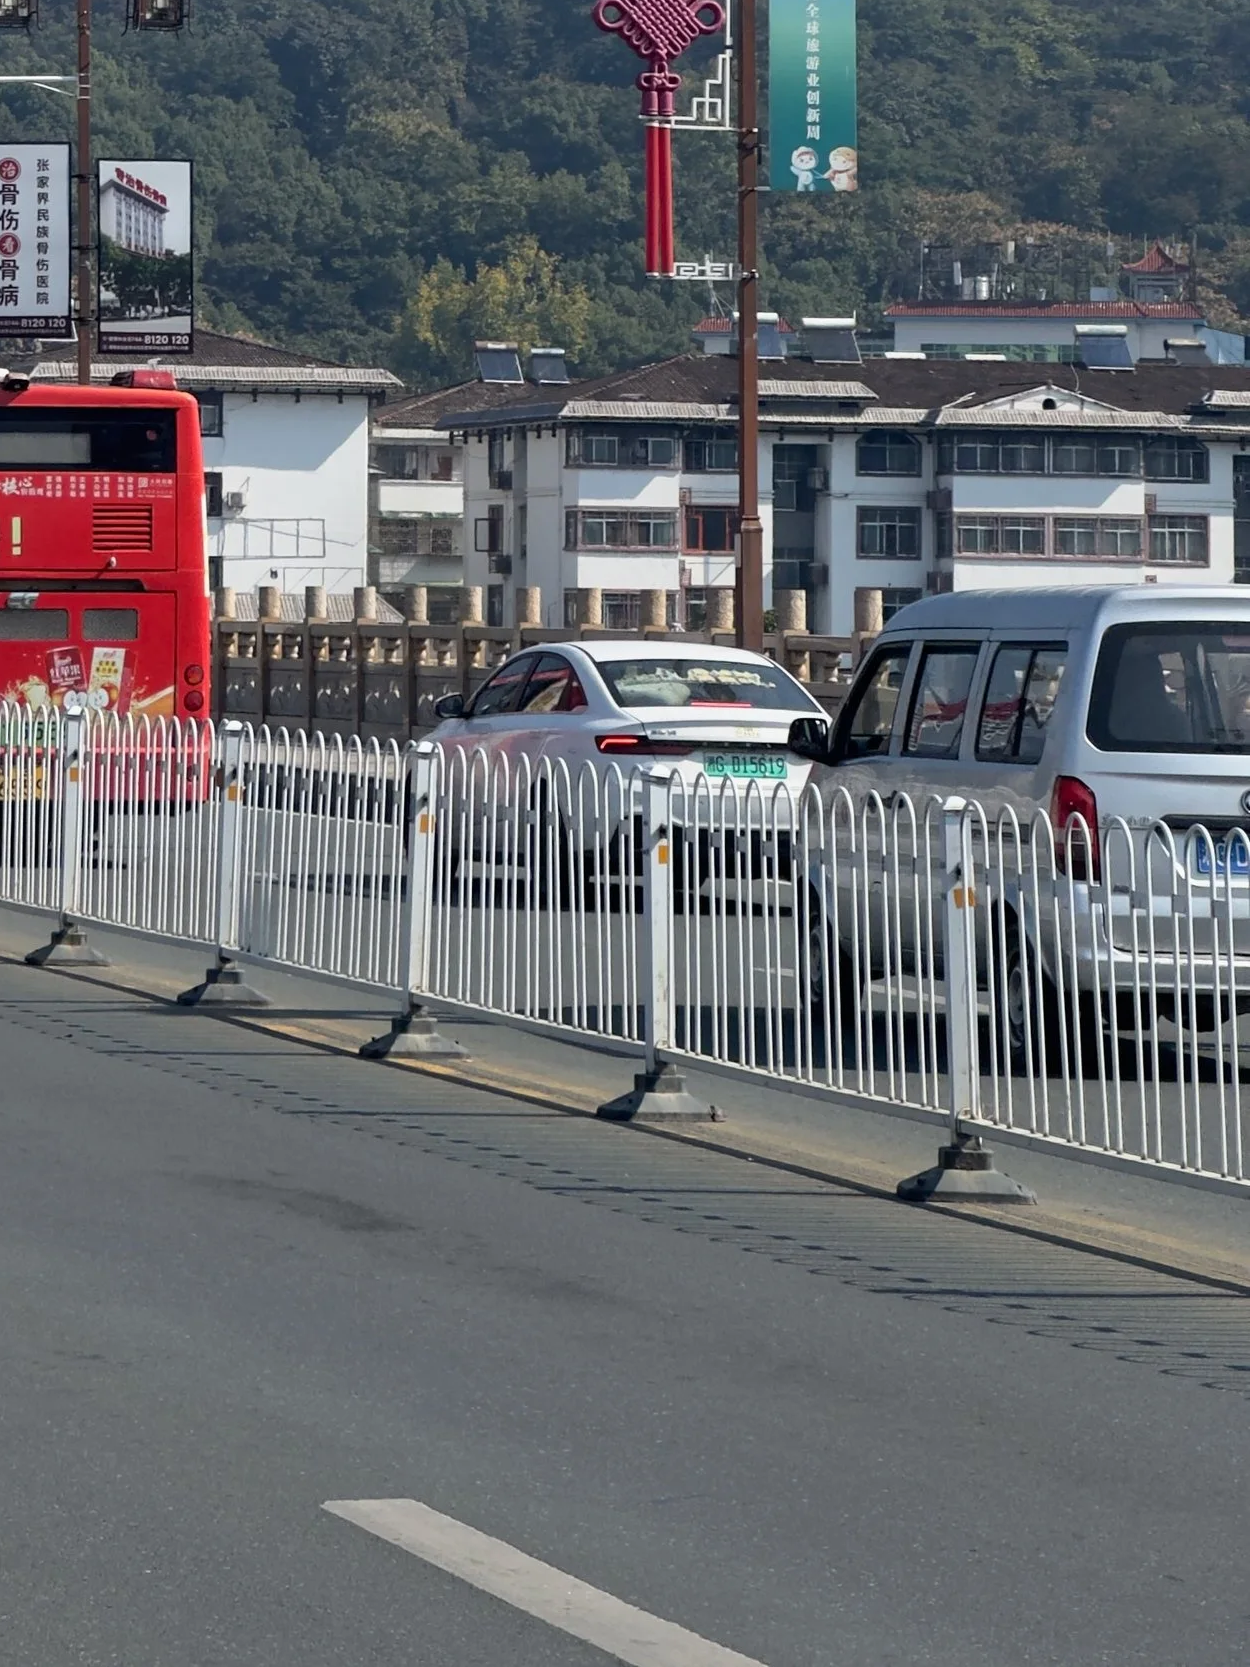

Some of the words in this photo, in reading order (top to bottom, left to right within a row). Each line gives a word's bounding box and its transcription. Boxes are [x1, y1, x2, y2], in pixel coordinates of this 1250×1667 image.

[36, 158, 50, 305] 张家界民族骨伤医院
[21, 318, 46, 328] 8120
[48, 318, 66, 328] 120
[144, 335, 169, 345] 8120
[171, 335, 189, 345] 120
